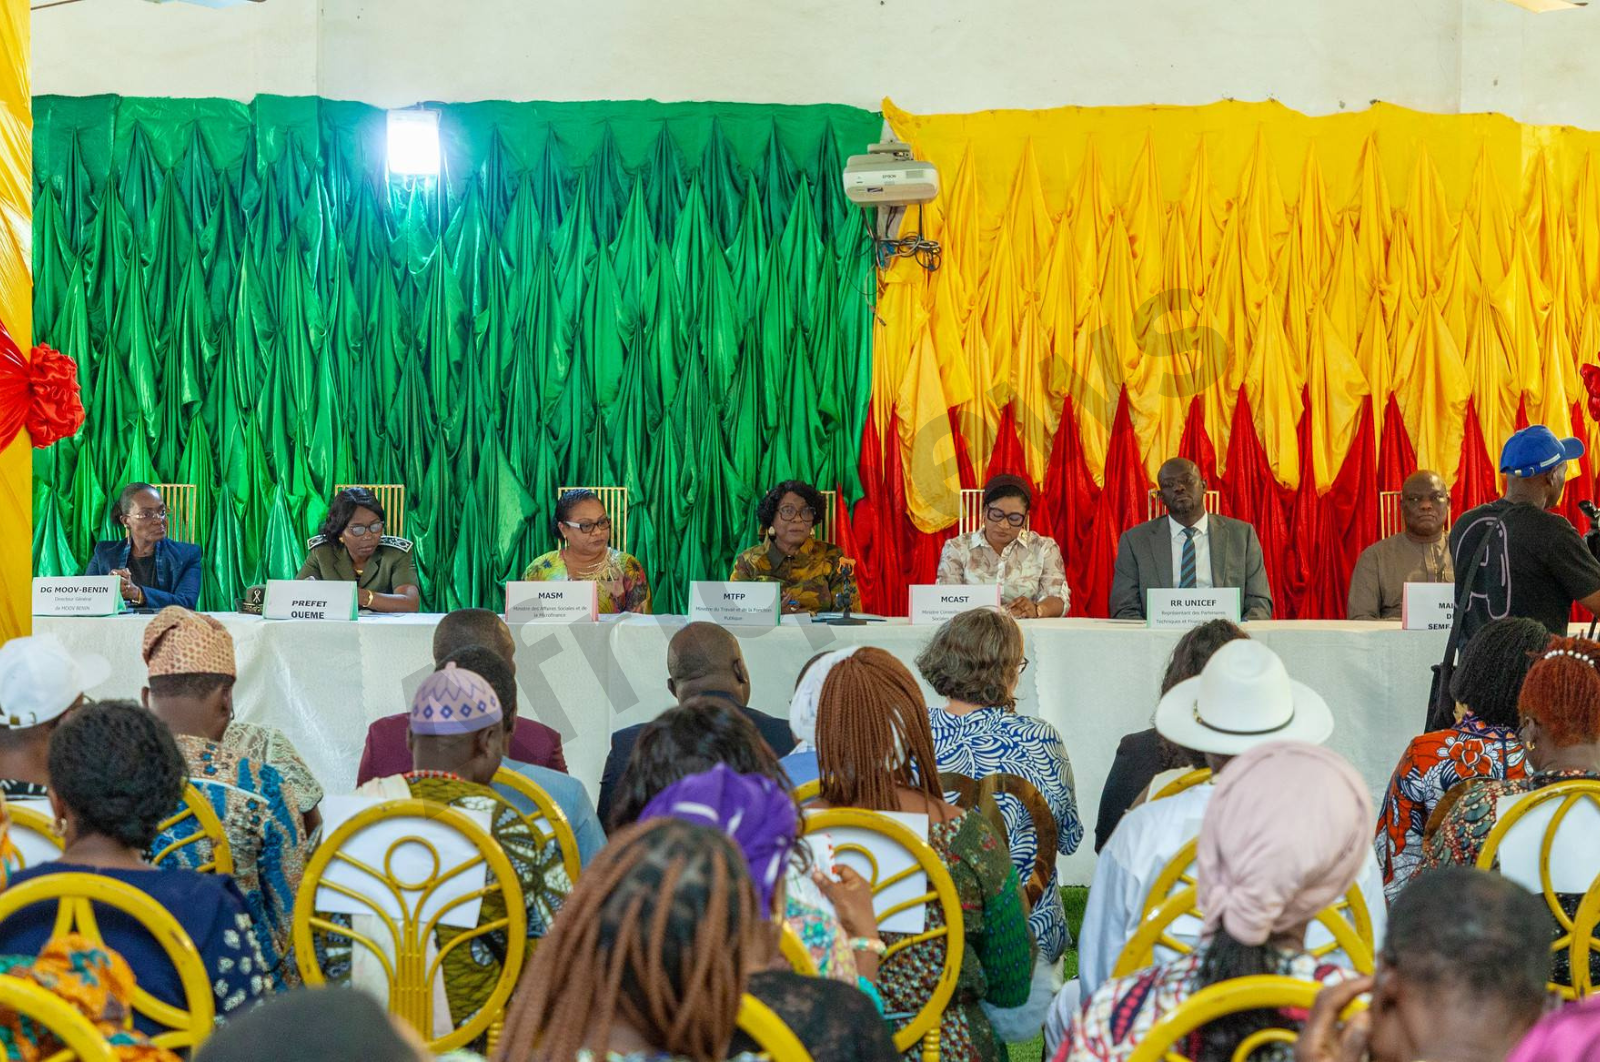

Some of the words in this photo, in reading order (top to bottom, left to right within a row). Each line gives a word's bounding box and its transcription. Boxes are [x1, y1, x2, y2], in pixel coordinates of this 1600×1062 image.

[1170, 599, 1182, 607] RR
[1184, 599, 1217, 607] UNICEF
[290, 611, 325, 619] OUEME
